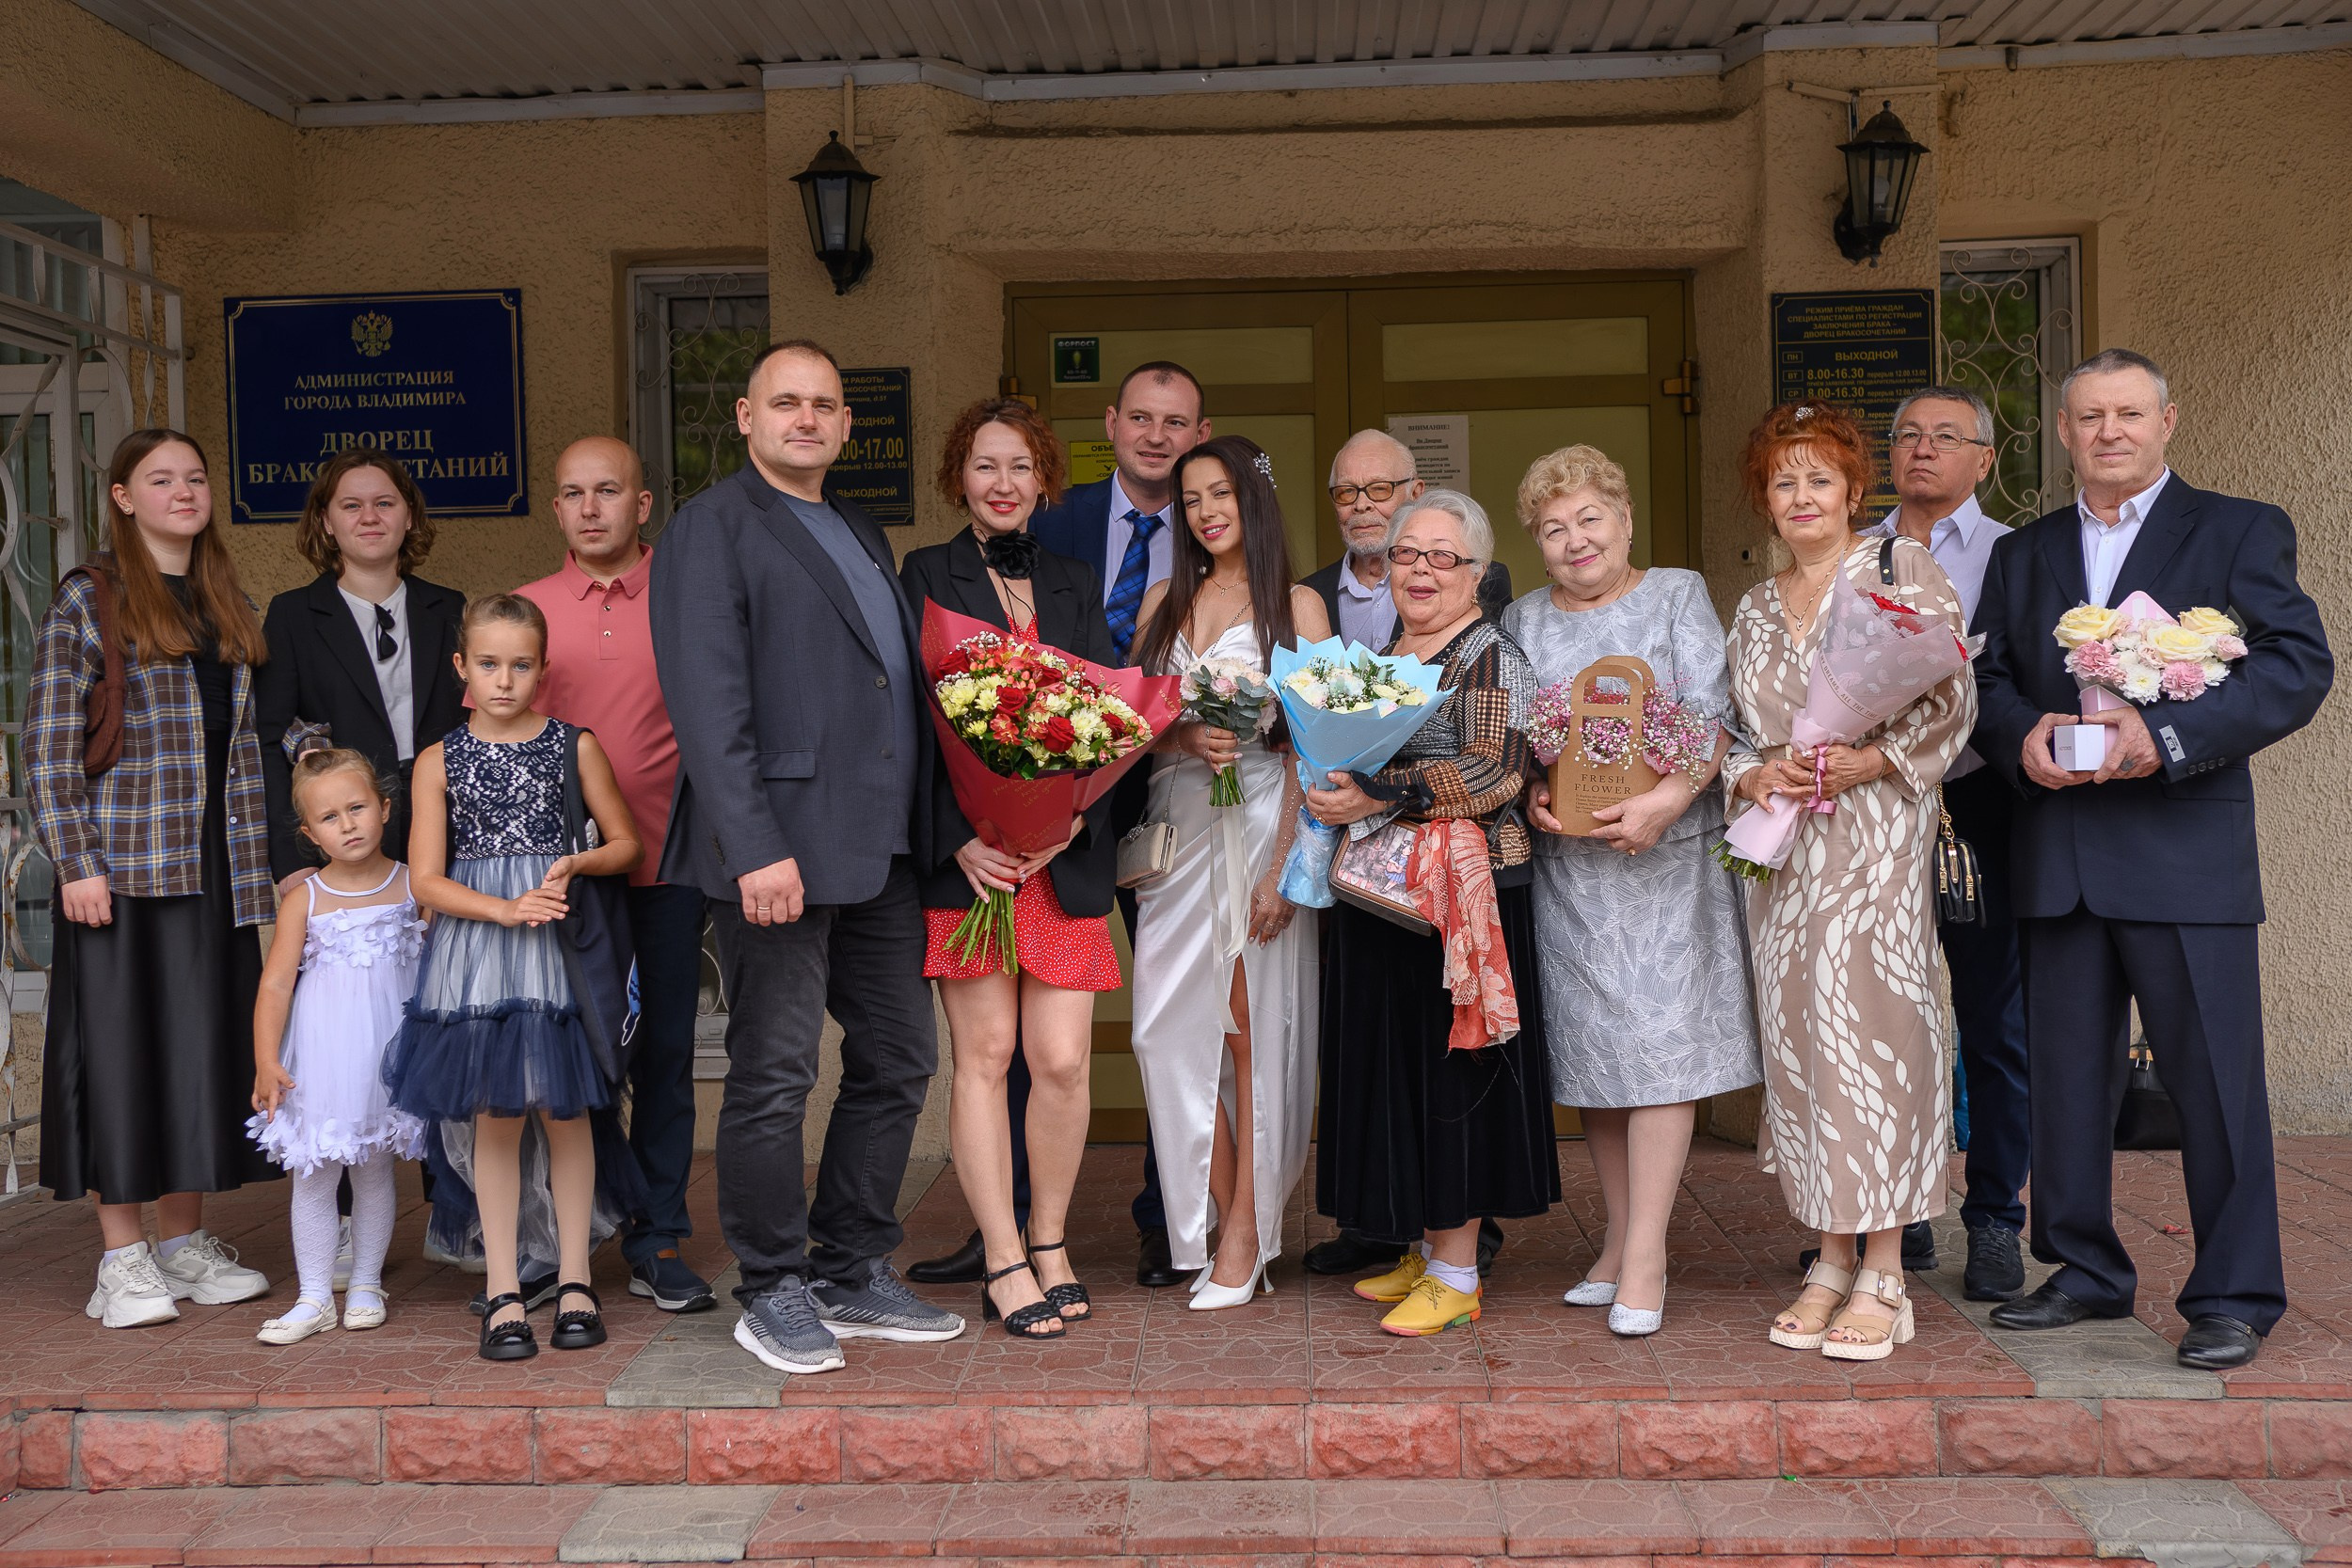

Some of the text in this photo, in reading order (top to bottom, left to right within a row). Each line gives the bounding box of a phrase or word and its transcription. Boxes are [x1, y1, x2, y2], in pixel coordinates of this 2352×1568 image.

[1788, 313, 1854, 323] СПЕЦИАЛИСТАМИ
[1868, 312, 1922, 320] РЕГИСТРАЦИИ
[1804, 328, 1907, 339] ДВОРЕЦ БРАКОСОЧЕТАНИЙ
[1836, 350, 1898, 362] ВЫХОДНОЙ
[1807, 368, 1864, 380] 8.00-16.30
[294, 371, 454, 390] АДМИНИСТРАЦИЯ
[1807, 387, 1864, 398] 8.00-16.30
[285, 391, 467, 410] ГОРОДА ВЛАДИМИРА
[851, 415, 895, 428] ХОДНОЙ
[320, 429, 434, 456] ДВОРЕЦ
[837, 437, 904, 461] .00-17.00
[864, 461, 907, 470] 12.00-13.00
[836, 486, 898, 499] ВЫХОДНОЙ
[1824, 665, 1839, 693] DREAMS,
[1841, 693, 1851, 704] ALL
[1853, 703, 1863, 713] THE
[1581, 774, 1624, 784] FRESH
[1574, 783, 1631, 794] FLOWER
